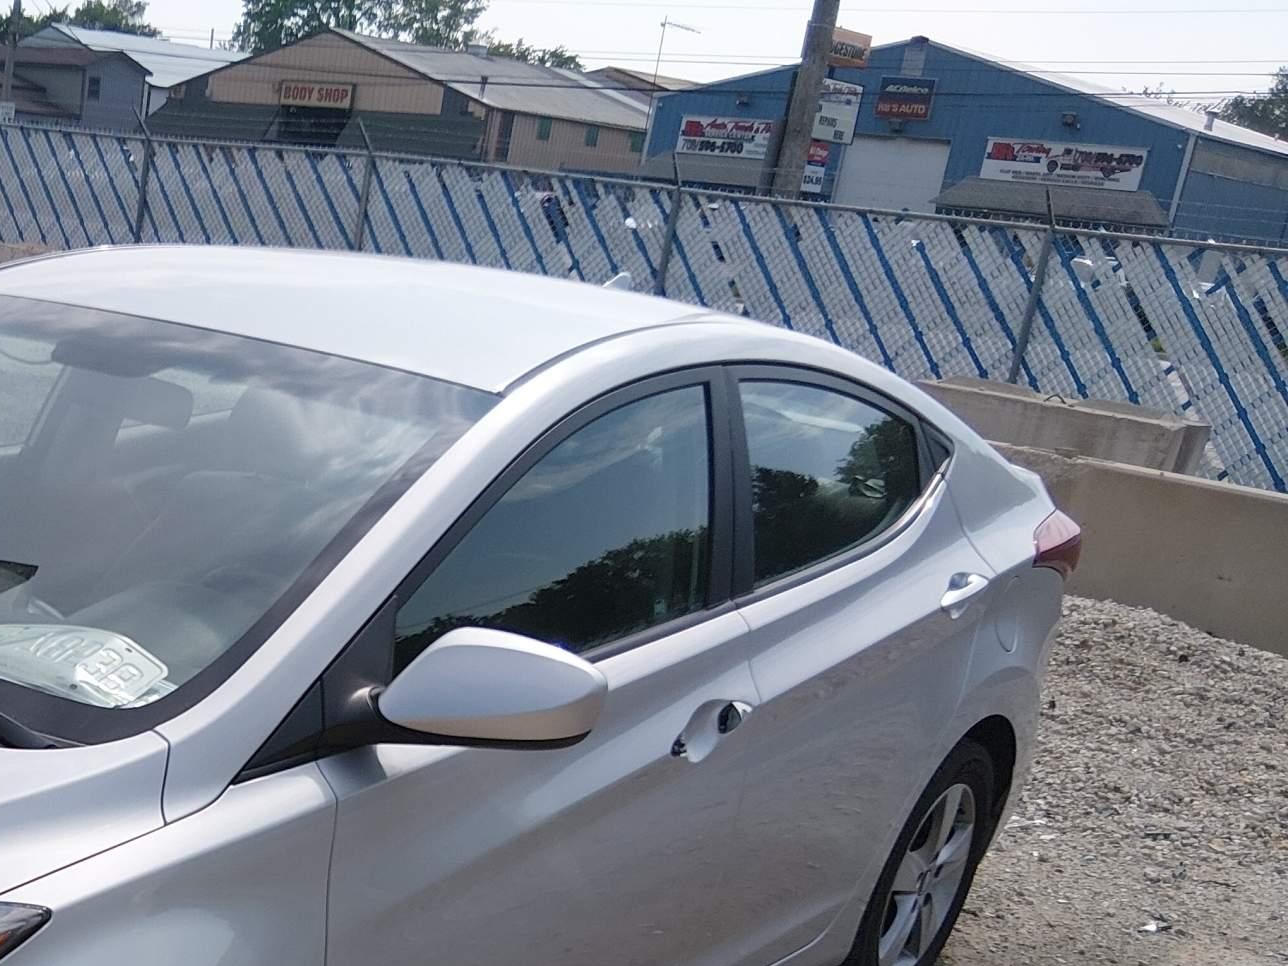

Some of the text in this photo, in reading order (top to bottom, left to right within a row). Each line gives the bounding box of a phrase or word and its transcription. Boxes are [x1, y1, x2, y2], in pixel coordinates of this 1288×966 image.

[284, 86, 349, 104] BODY SHOP
[899, 104, 926, 114] AUTO
